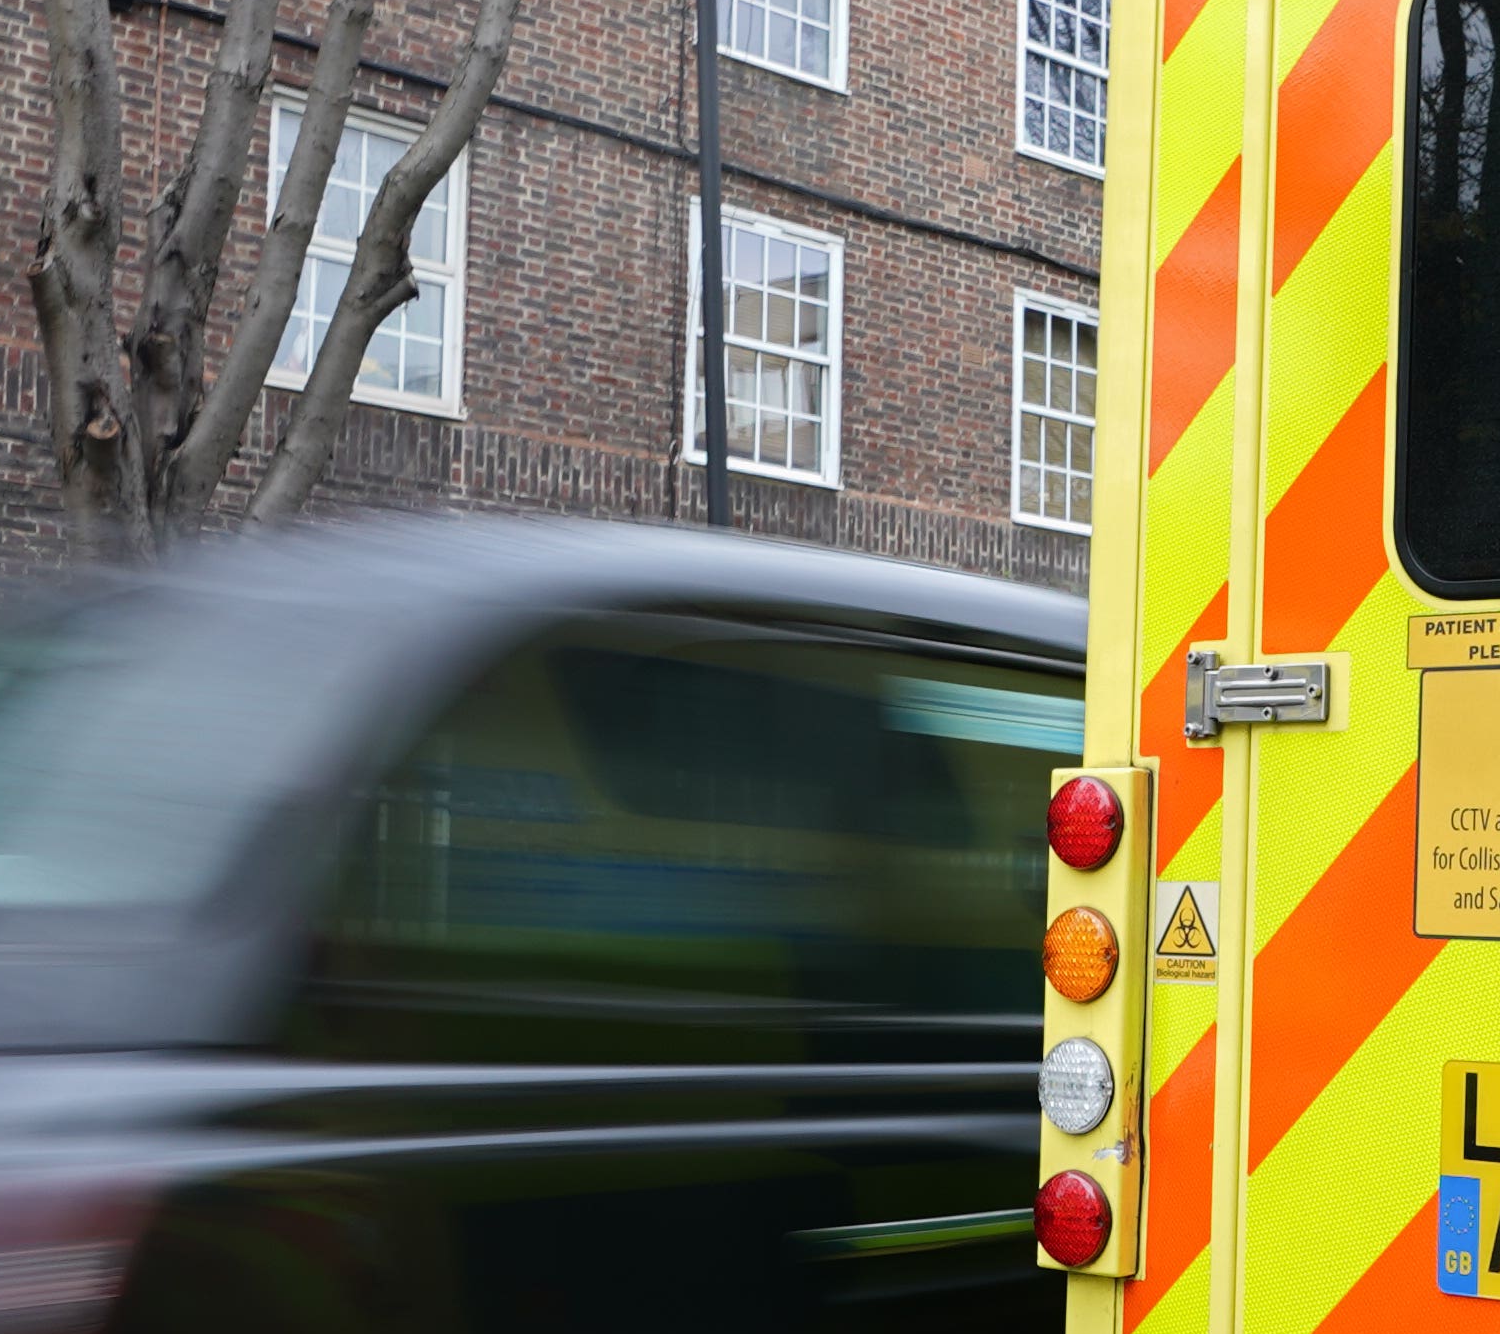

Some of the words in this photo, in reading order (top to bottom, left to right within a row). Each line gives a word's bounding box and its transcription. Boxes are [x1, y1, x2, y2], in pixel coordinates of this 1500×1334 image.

[1424, 618, 1497, 637] PATIENT
[1450, 808, 1490, 832] CCTV
[1432, 846, 1455, 870] for
[1453, 887, 1484, 910] and
[1156, 969, 1191, 979] Biological
[1192, 969, 1215, 979] hazard
[1166, 958, 1206, 969] CAUTION
[1445, 1249, 1472, 1276] GB
